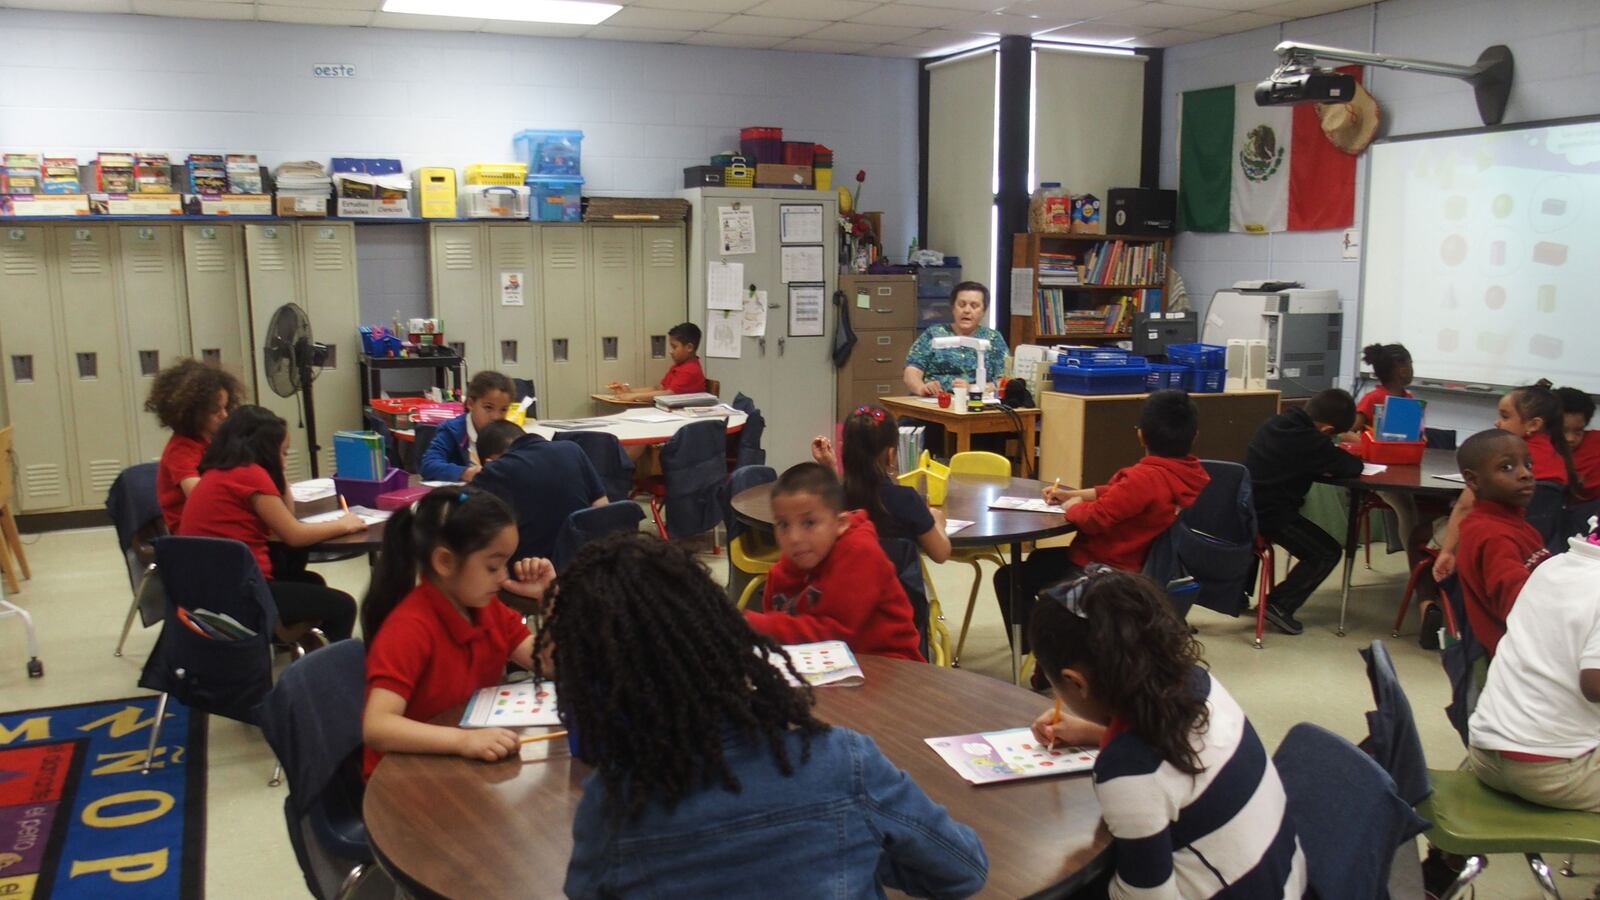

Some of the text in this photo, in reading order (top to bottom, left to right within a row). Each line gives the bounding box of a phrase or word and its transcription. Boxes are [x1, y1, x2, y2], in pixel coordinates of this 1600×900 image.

[315, 65, 354, 76] oeste
[81, 789, 175, 828] O
[13, 818, 41, 851] perro
[69, 847, 169, 882] P
